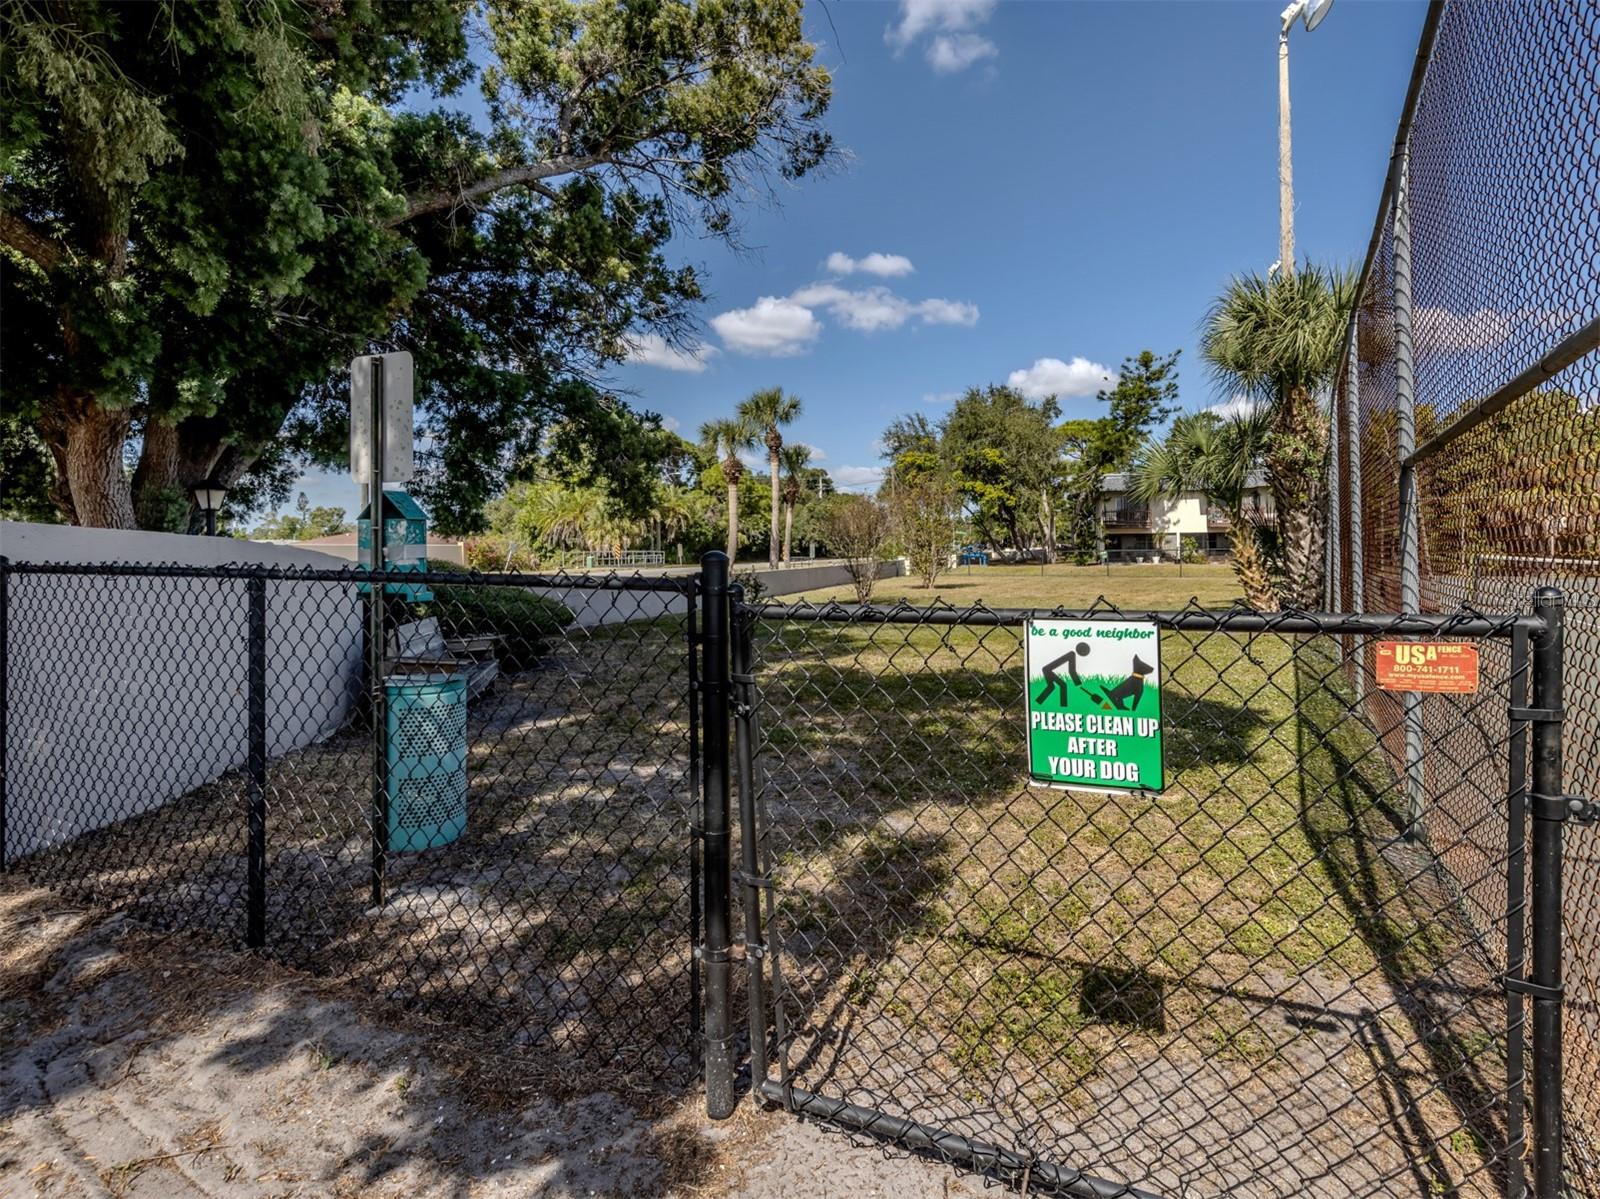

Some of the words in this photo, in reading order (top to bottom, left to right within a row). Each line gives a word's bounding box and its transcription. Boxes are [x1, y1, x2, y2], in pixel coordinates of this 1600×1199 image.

[1031, 626, 1045, 636] be
[1049, 627, 1058, 637] a
[1062, 627, 1092, 639] good
[1096, 628, 1155, 640] neighbor
[1395, 644, 1437, 665] USA
[1437, 645, 1462, 654] FENCE
[1393, 665, 1460, 674] 800-741-1711
[1031, 711, 1084, 733] PLEASE
[1086, 714, 1135, 736] CLEAN
[1137, 717, 1160, 738] UP
[1067, 736, 1118, 757] AFTER
[1048, 756, 1097, 779] YOUR
[1100, 760, 1140, 783] DOG
